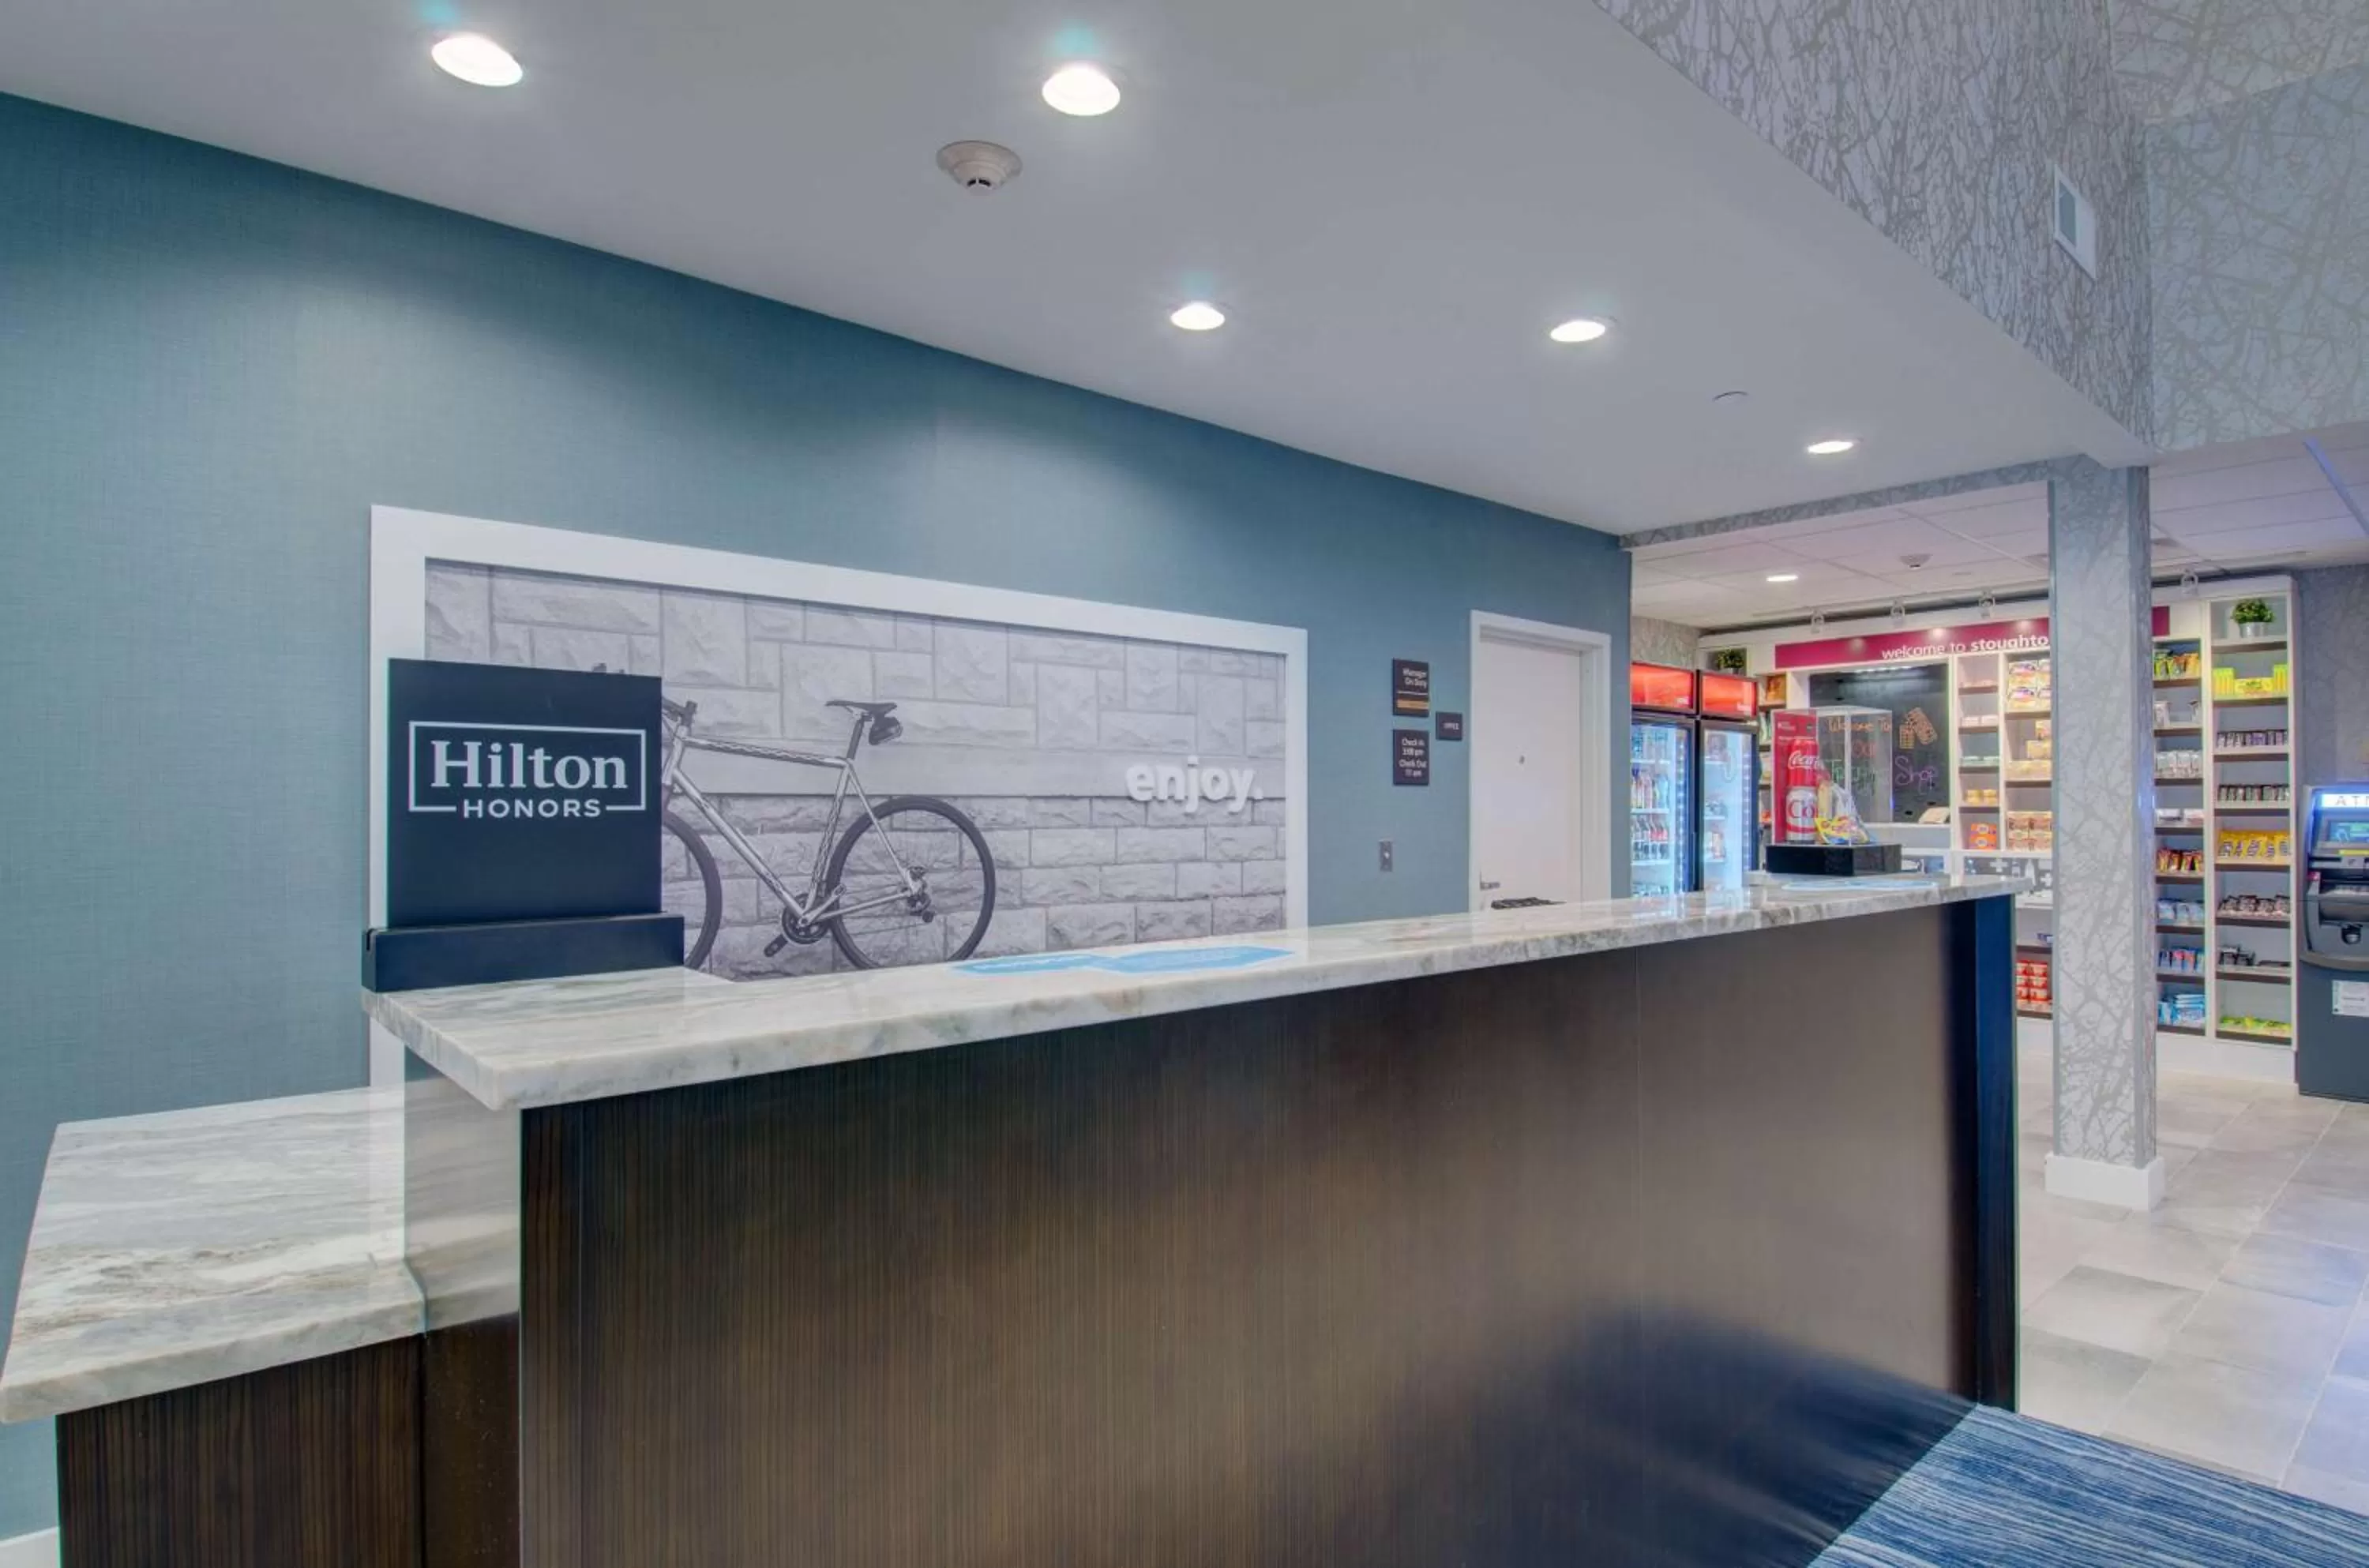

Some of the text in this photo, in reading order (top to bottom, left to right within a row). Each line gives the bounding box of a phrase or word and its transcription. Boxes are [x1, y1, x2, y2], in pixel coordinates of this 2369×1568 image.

[1882, 644, 1945, 659] welcome
[1950, 642, 1965, 654] to
[430, 740, 628, 790] Hilton
[1125, 755, 1264, 814] enjoy.
[463, 798, 602, 819] HONORS
[2335, 795, 2369, 808] AT
